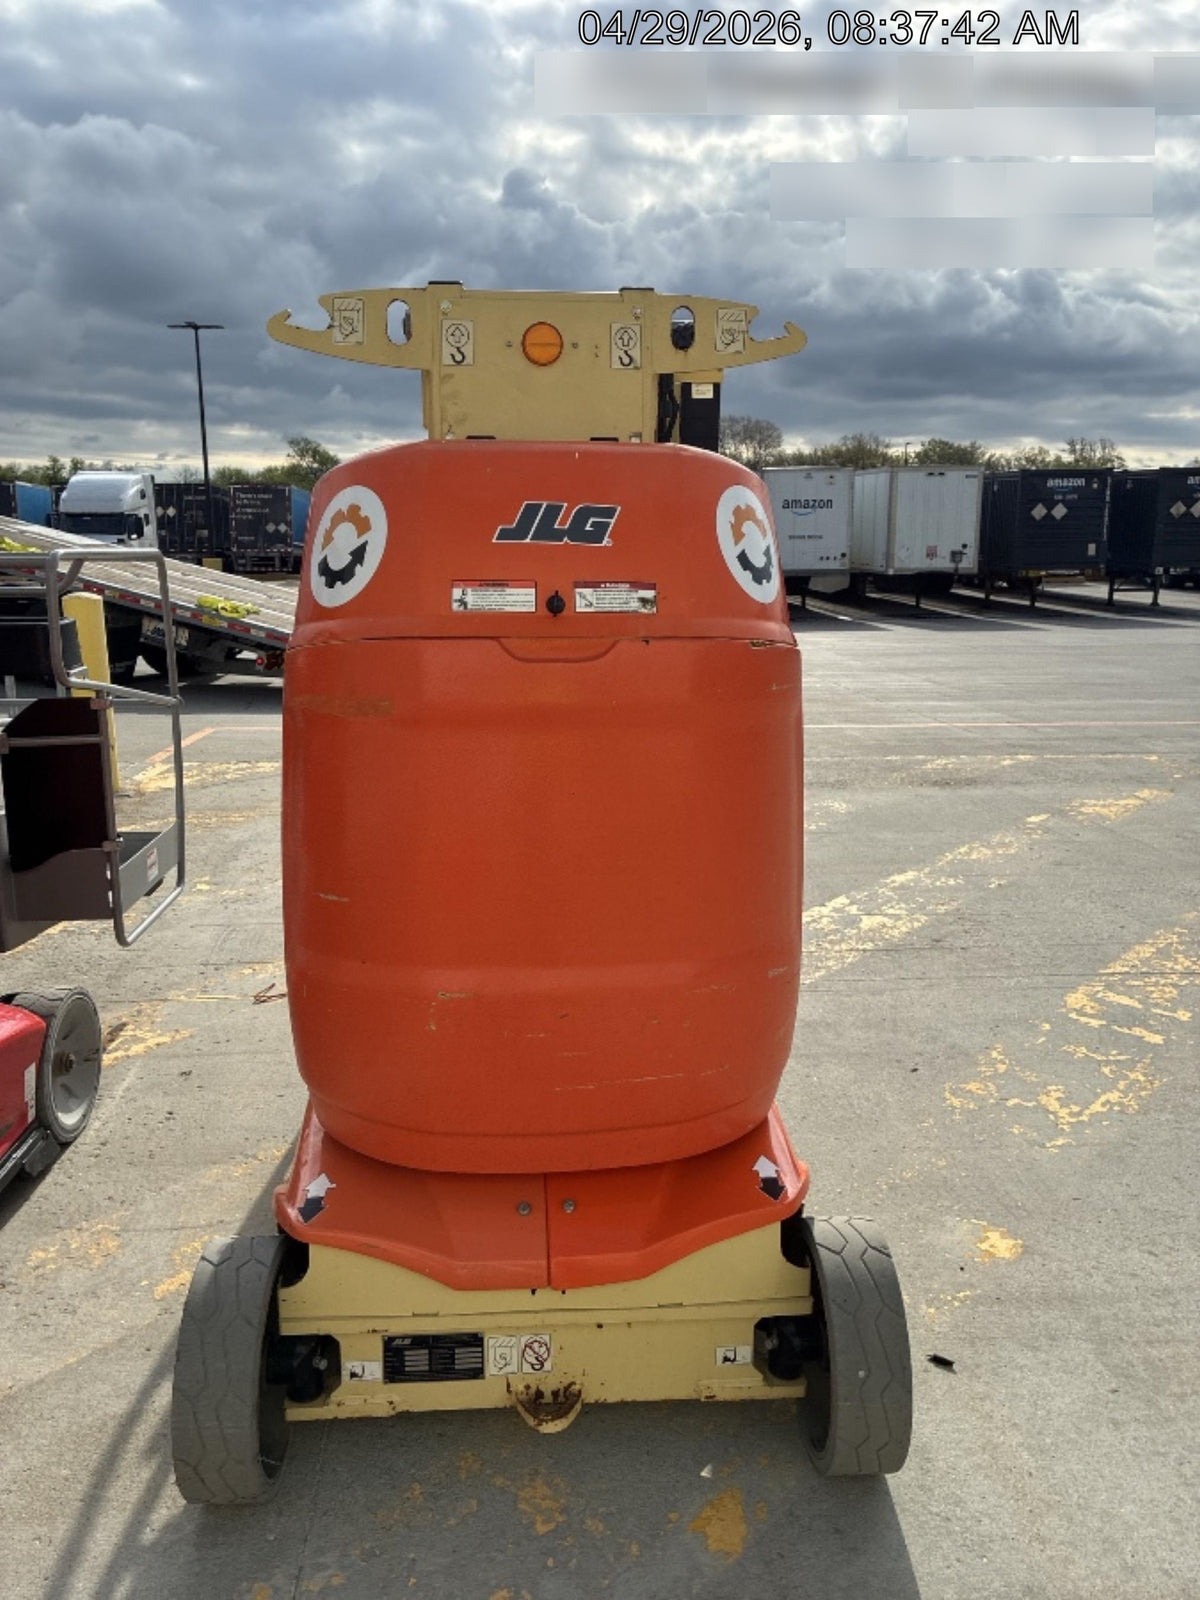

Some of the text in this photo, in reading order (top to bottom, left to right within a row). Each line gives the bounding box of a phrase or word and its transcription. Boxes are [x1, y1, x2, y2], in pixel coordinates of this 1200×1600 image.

[1046, 477, 1086, 488] amazon
[782, 498, 833, 510] amazon
[492, 501, 621, 546] JLG
